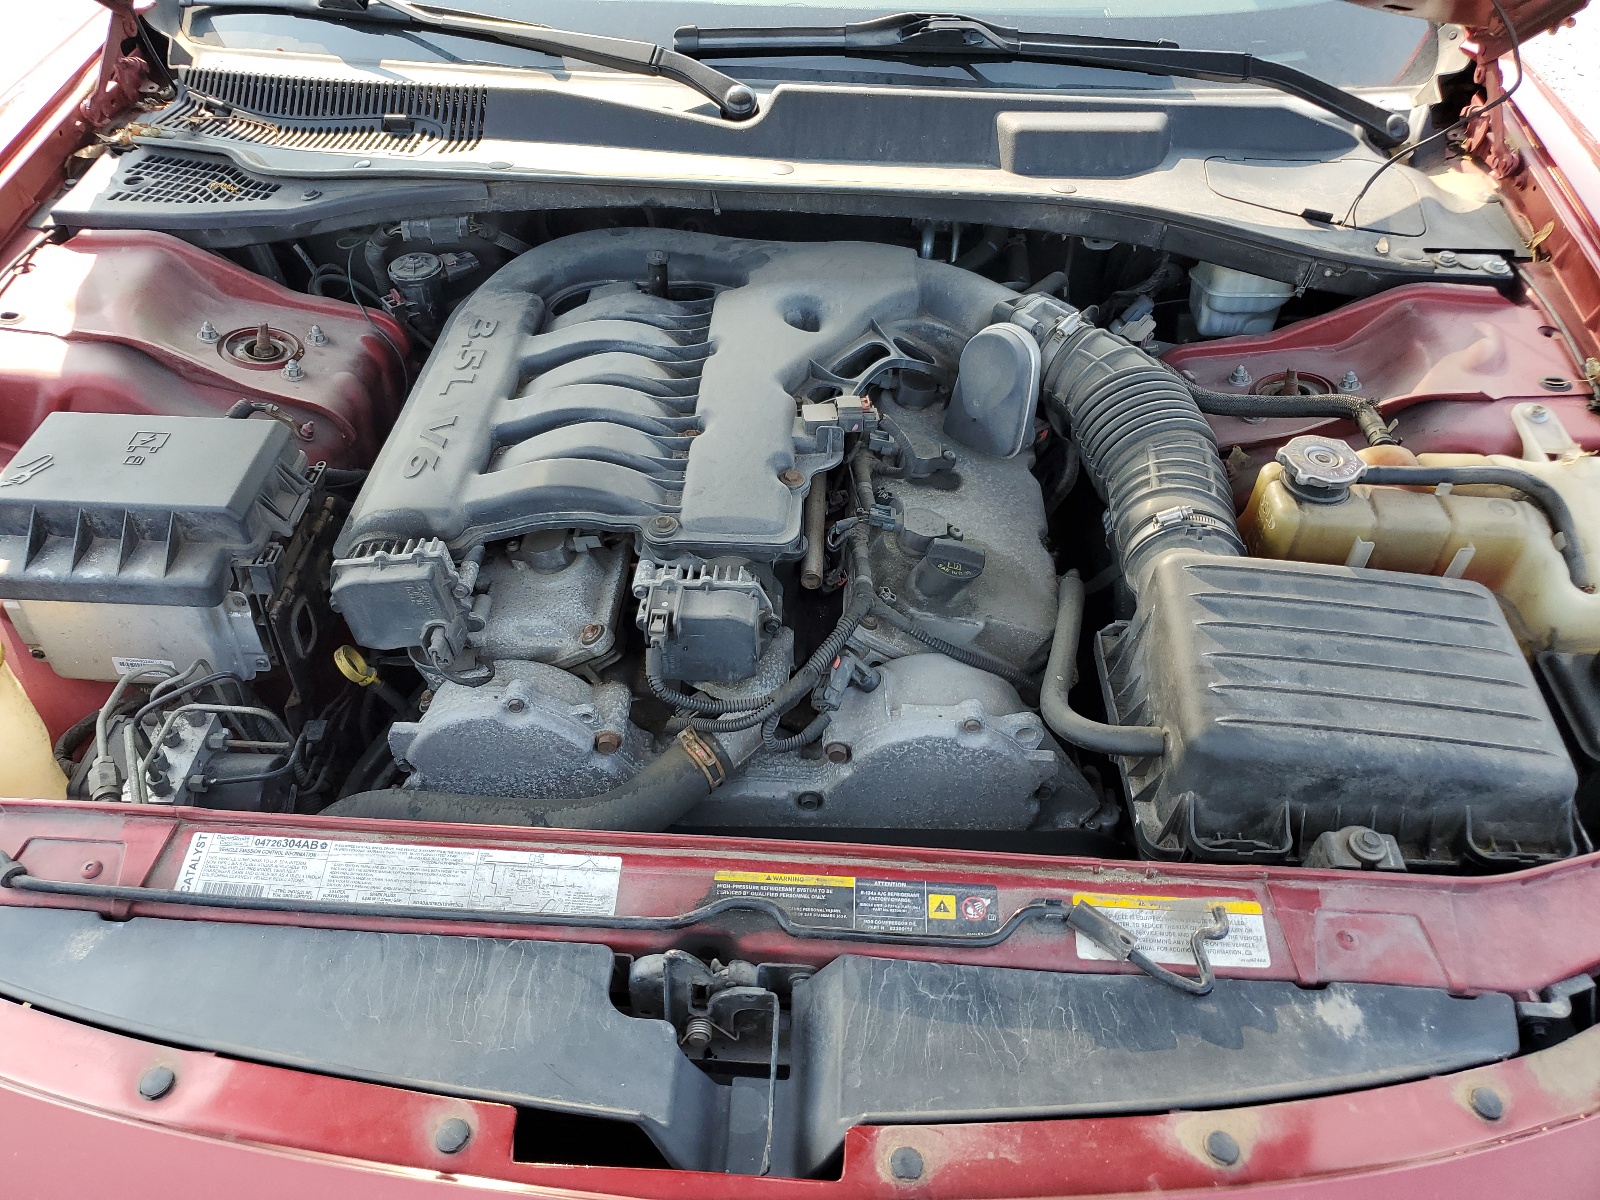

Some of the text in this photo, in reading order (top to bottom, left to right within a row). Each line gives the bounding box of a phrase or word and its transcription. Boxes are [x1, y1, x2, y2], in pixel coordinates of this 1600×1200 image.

[403, 319, 499, 479] 3.5L V6
[253, 837, 319, 849] 04726304AB
[180, 834, 208, 891] CATALYST
[1205, 947, 1243, 956] NFORMATION.
